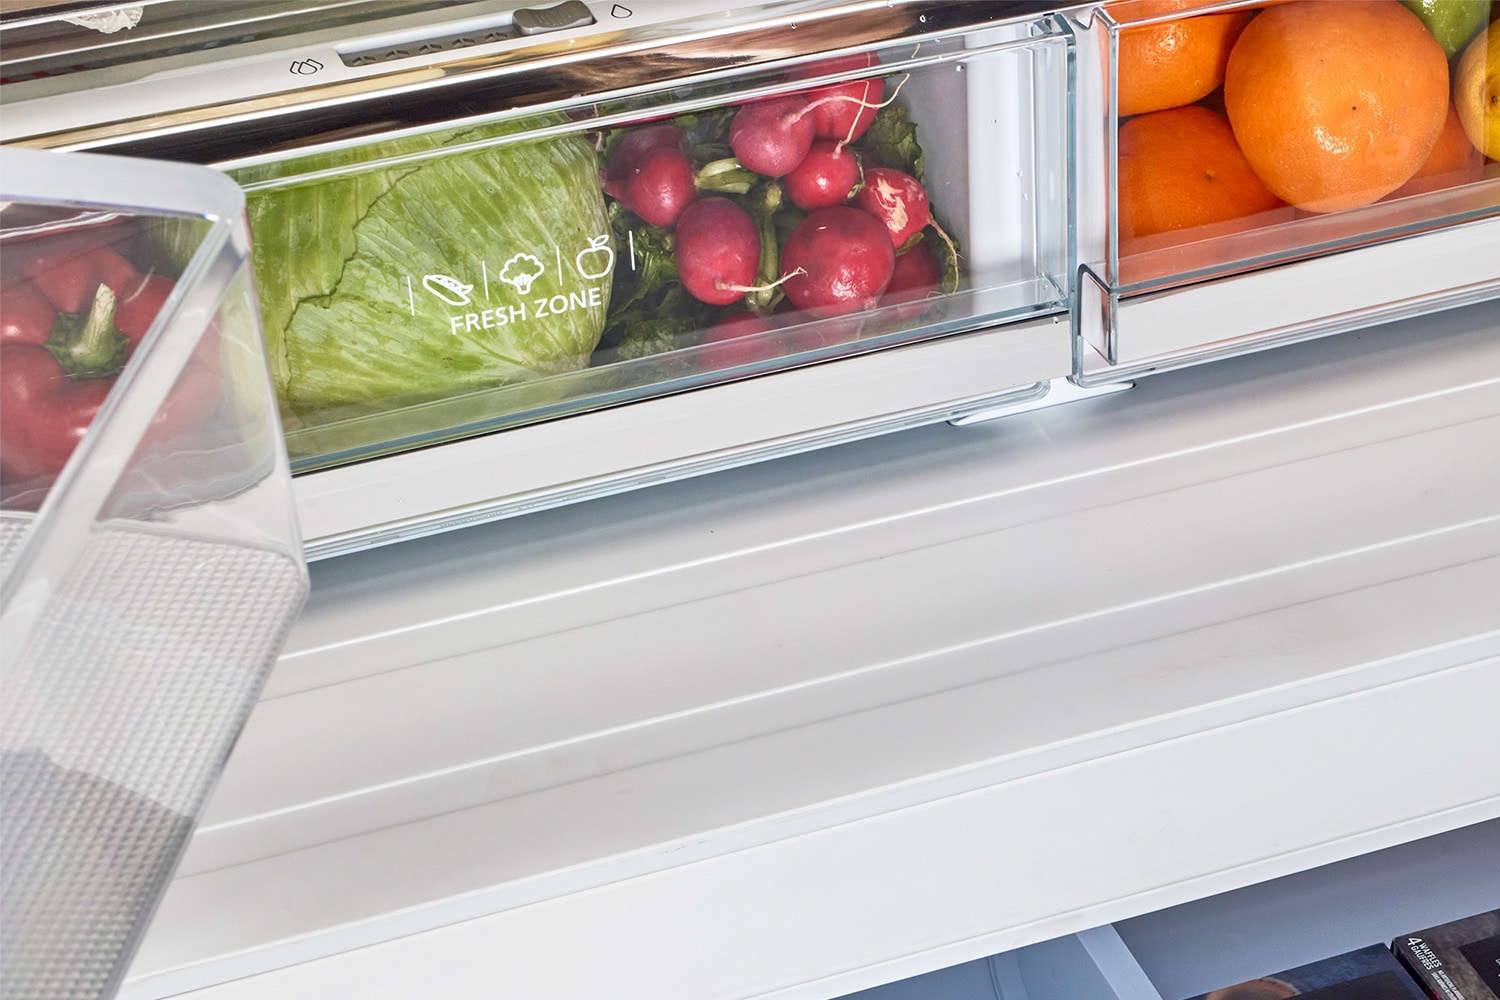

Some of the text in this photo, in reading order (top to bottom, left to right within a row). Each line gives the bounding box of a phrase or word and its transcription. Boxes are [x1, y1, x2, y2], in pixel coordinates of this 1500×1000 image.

[450, 287, 602, 336] FRESH ZONE
[1408, 938, 1422, 946] 4
[1410, 945, 1434, 970] GAUFRES
[1419, 942, 1442, 968] WAFFLES
